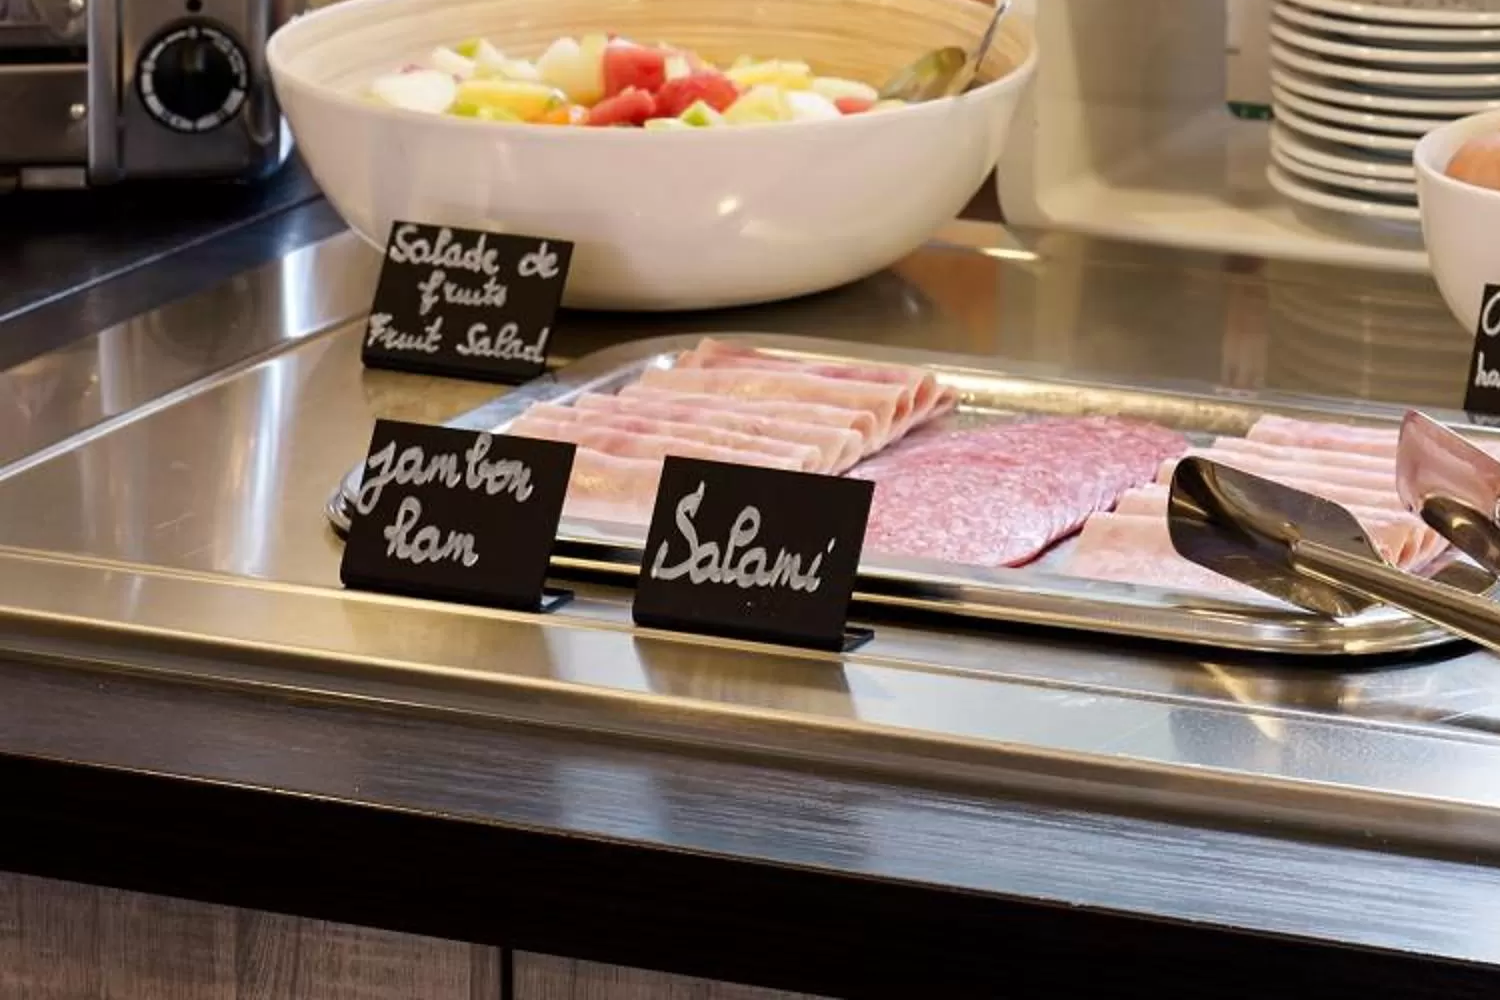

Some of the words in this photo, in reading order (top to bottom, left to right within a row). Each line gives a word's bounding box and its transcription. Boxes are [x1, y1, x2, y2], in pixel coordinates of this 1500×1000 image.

[390, 224, 499, 275] Salade
[518, 242, 559, 279] de
[367, 312, 443, 353] Fruit
[456, 322, 549, 363] Salad
[384, 496, 479, 567] ham
[651, 480, 836, 592] Salami
